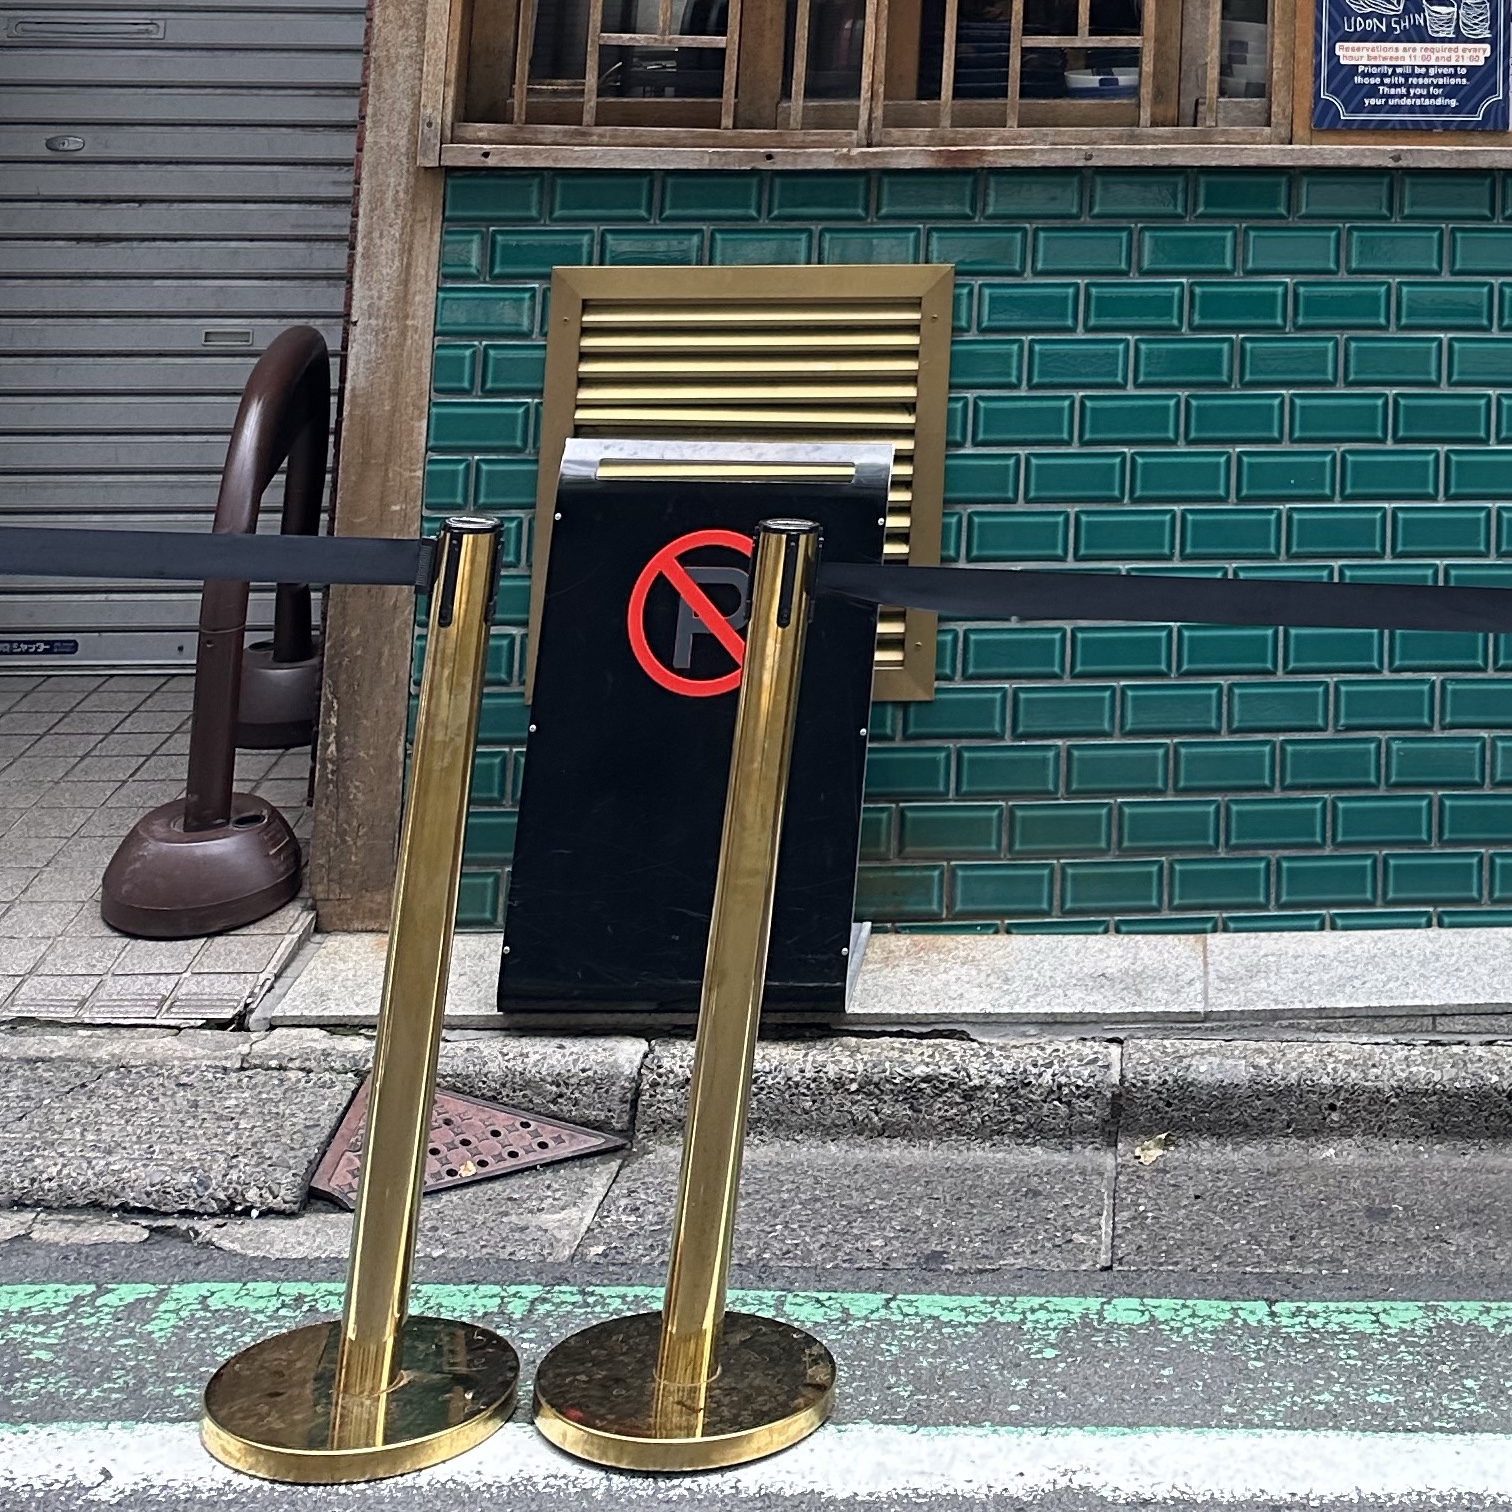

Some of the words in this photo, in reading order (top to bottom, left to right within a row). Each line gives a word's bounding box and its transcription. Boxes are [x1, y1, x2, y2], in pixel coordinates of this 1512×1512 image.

[1343, 16, 1387, 33] UDON
[1391, 12, 1425, 34] SHIN
[1338, 44, 1400, 53] Reservations
[1420, 45, 1459, 55] required
[1461, 47, 1488, 56] every
[1342, 54, 1364, 62] hour
[1435, 55, 1450, 63] and
[1358, 65, 1394, 75] Priority
[1395, 65, 1412, 74] will
[1415, 66, 1427, 74] be
[1428, 66, 1455, 76] given
[1457, 67, 1467, 75] to
[1354, 76, 1381, 85] those
[1383, 76, 1405, 85] with
[1408, 76, 1470, 85] reservations.
[1378, 86, 1407, 95] Thank
[1409, 88, 1427, 97] you
[1429, 86, 1444, 95] for
[1364, 98, 1386, 106] your
[1388, 97, 1460, 108] understanding.
